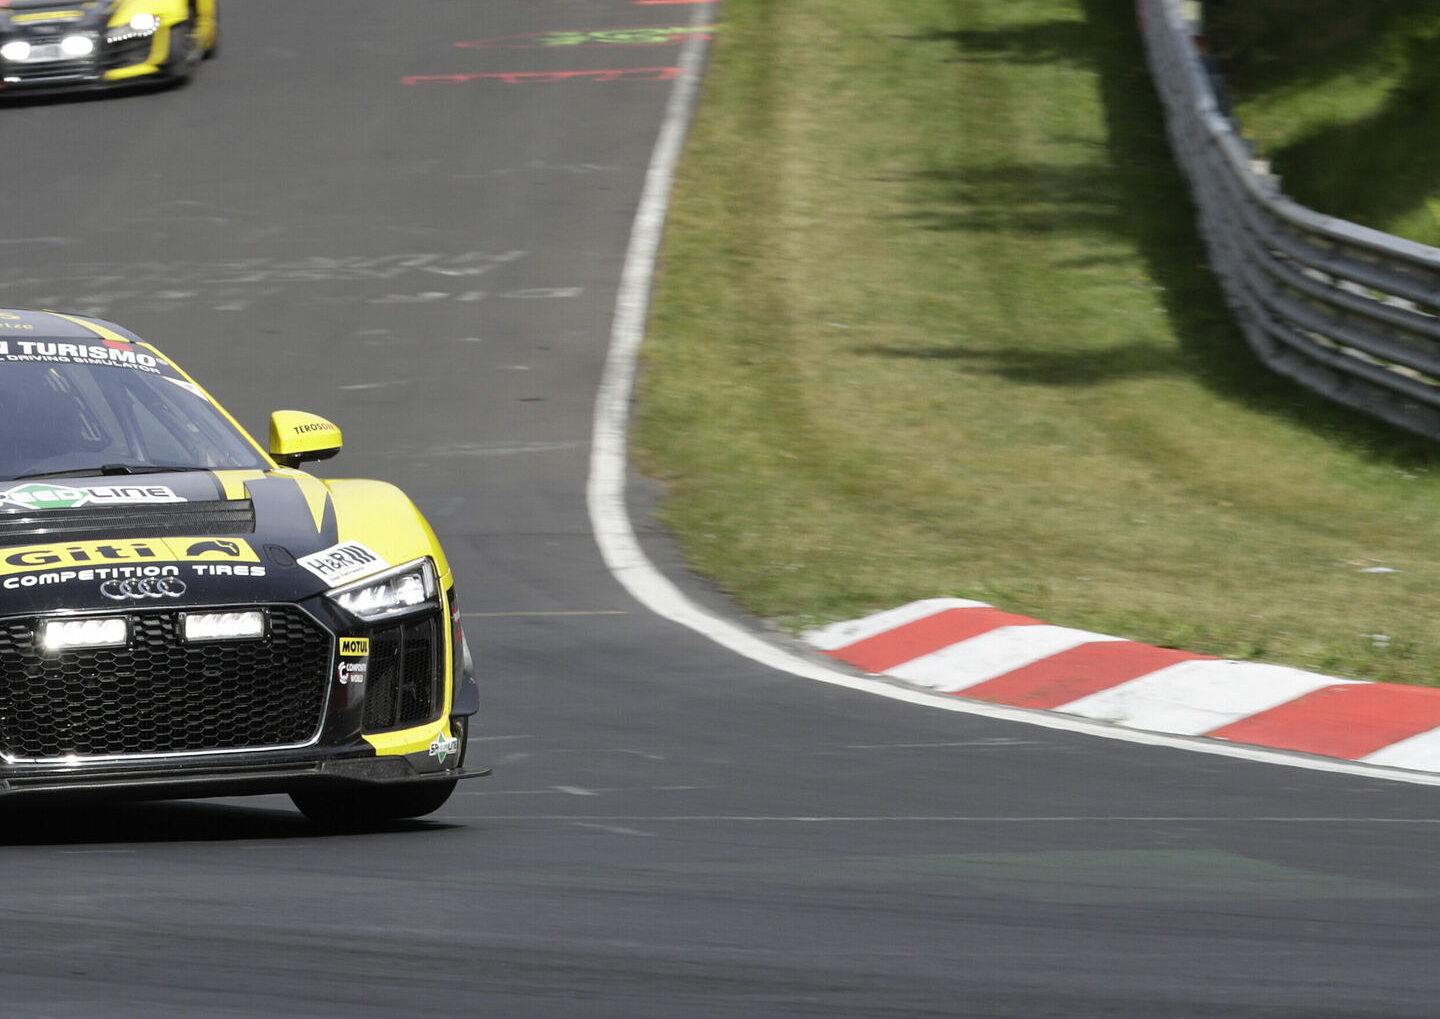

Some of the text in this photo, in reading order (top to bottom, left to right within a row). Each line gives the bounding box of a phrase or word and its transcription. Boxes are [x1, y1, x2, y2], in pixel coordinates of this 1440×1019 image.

[6, 354, 71, 362] DRIVING
[73, 356, 161, 374] SIMULATOR
[17, 341, 159, 368] TURISMO
[293, 423, 335, 435] TEROSON
[5, 542, 164, 567] Giti
[306, 552, 355, 575] H&R
[3, 564, 267, 590] COMPETITION TIRES
[342, 640, 368, 654] MOTUL
